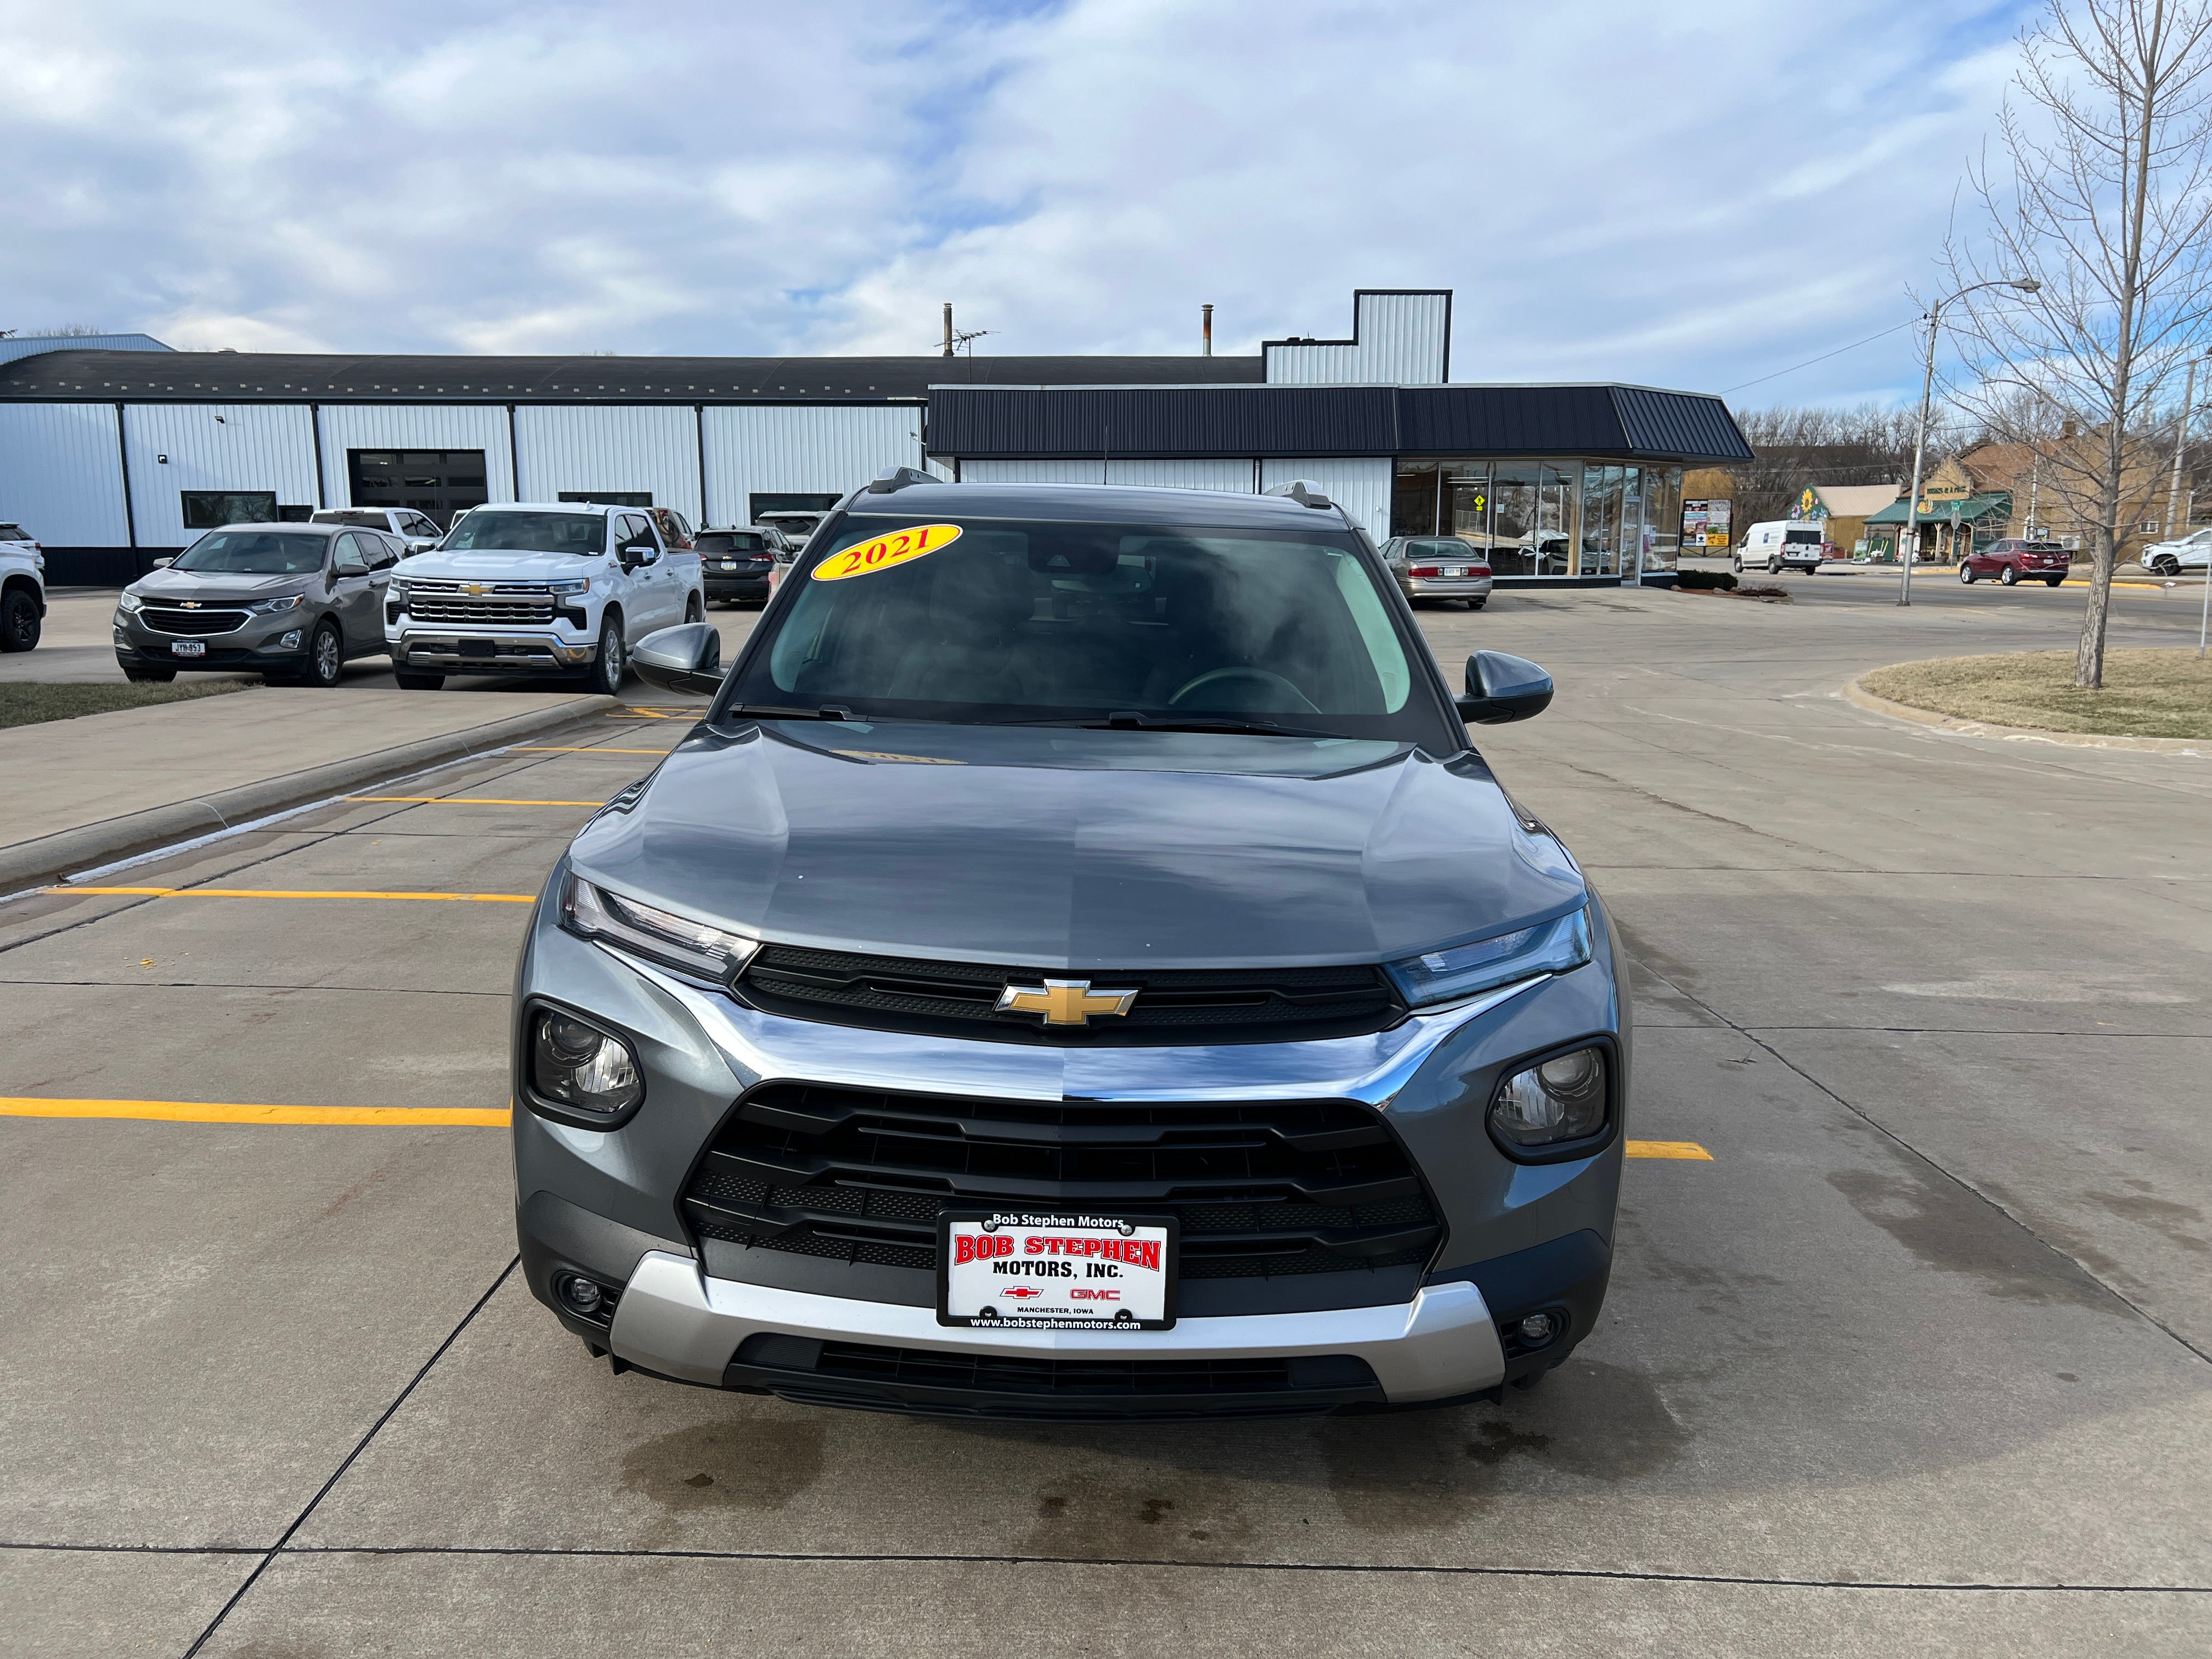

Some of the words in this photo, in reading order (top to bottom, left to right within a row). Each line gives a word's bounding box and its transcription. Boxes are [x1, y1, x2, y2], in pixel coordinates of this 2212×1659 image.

[841, 528, 930, 574] 2021
[189, 644, 201, 652] 953
[992, 1214, 1018, 1224] Bob
[1022, 1215, 1073, 1227] Stephen
[1078, 1216, 1124, 1228] Motors
[955, 1234, 1014, 1265] BOB
[1025, 1237, 1161, 1271] STEPHEN
[992, 1261, 1077, 1280] MOTORS,
[1086, 1263, 1124, 1278] INC.
[1070, 1288, 1121, 1301] GMC
[1017, 1306, 1071, 1314] MANCHESTER,
[970, 1317, 1141, 1330] www.bobstephenmotors.com
